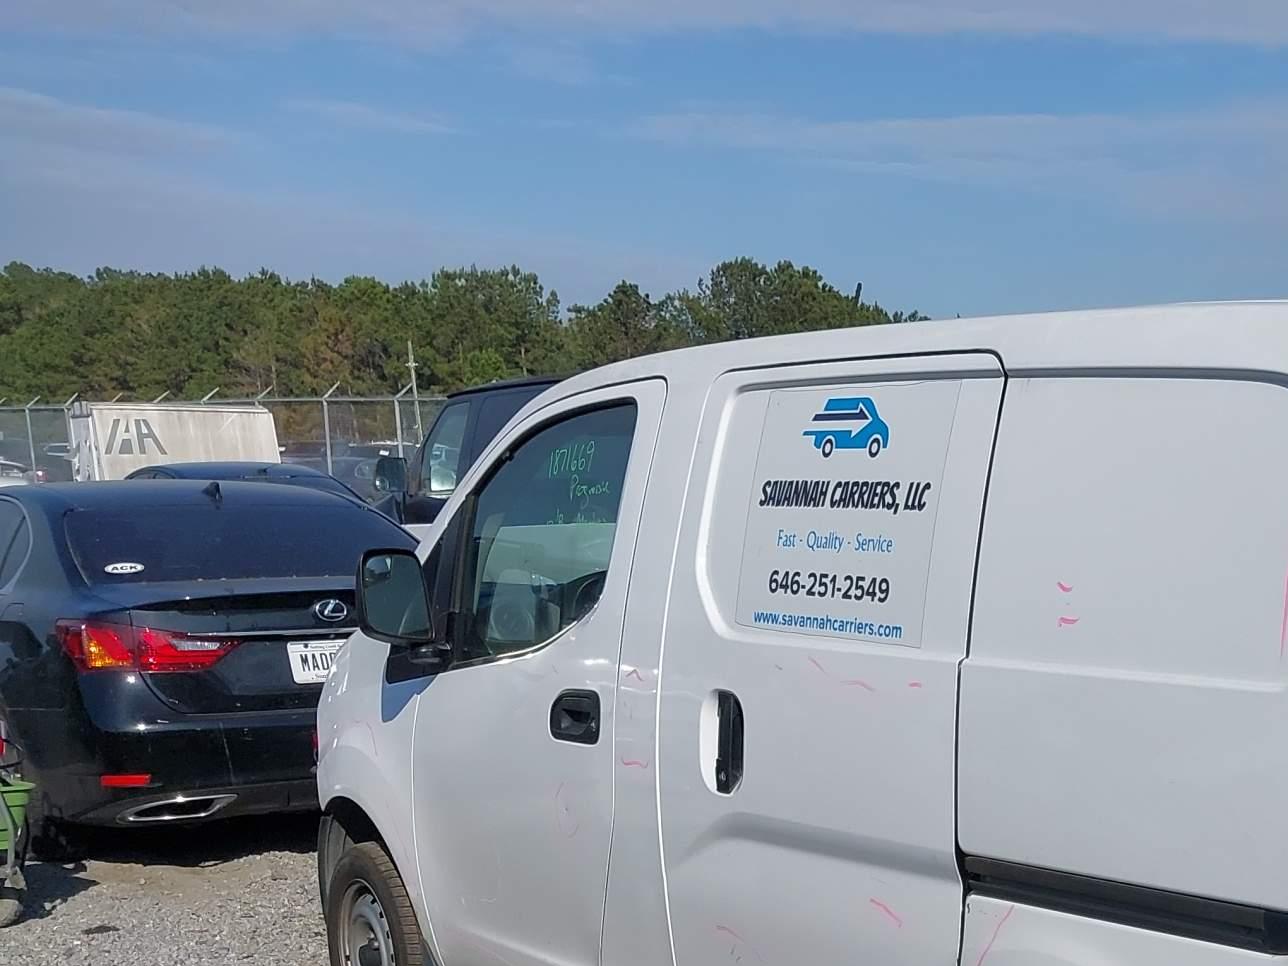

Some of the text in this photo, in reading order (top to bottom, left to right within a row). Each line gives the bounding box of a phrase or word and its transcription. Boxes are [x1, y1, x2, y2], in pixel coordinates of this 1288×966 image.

[758, 479, 932, 515] SAVANNAH CARRIERS, LLC
[776, 528, 797, 548] Fast
[806, 530, 845, 554] Quality
[854, 533, 893, 553] Service
[768, 569, 890, 604] 646-251-2549
[753, 610, 903, 639] www.savannahcarriers.com
